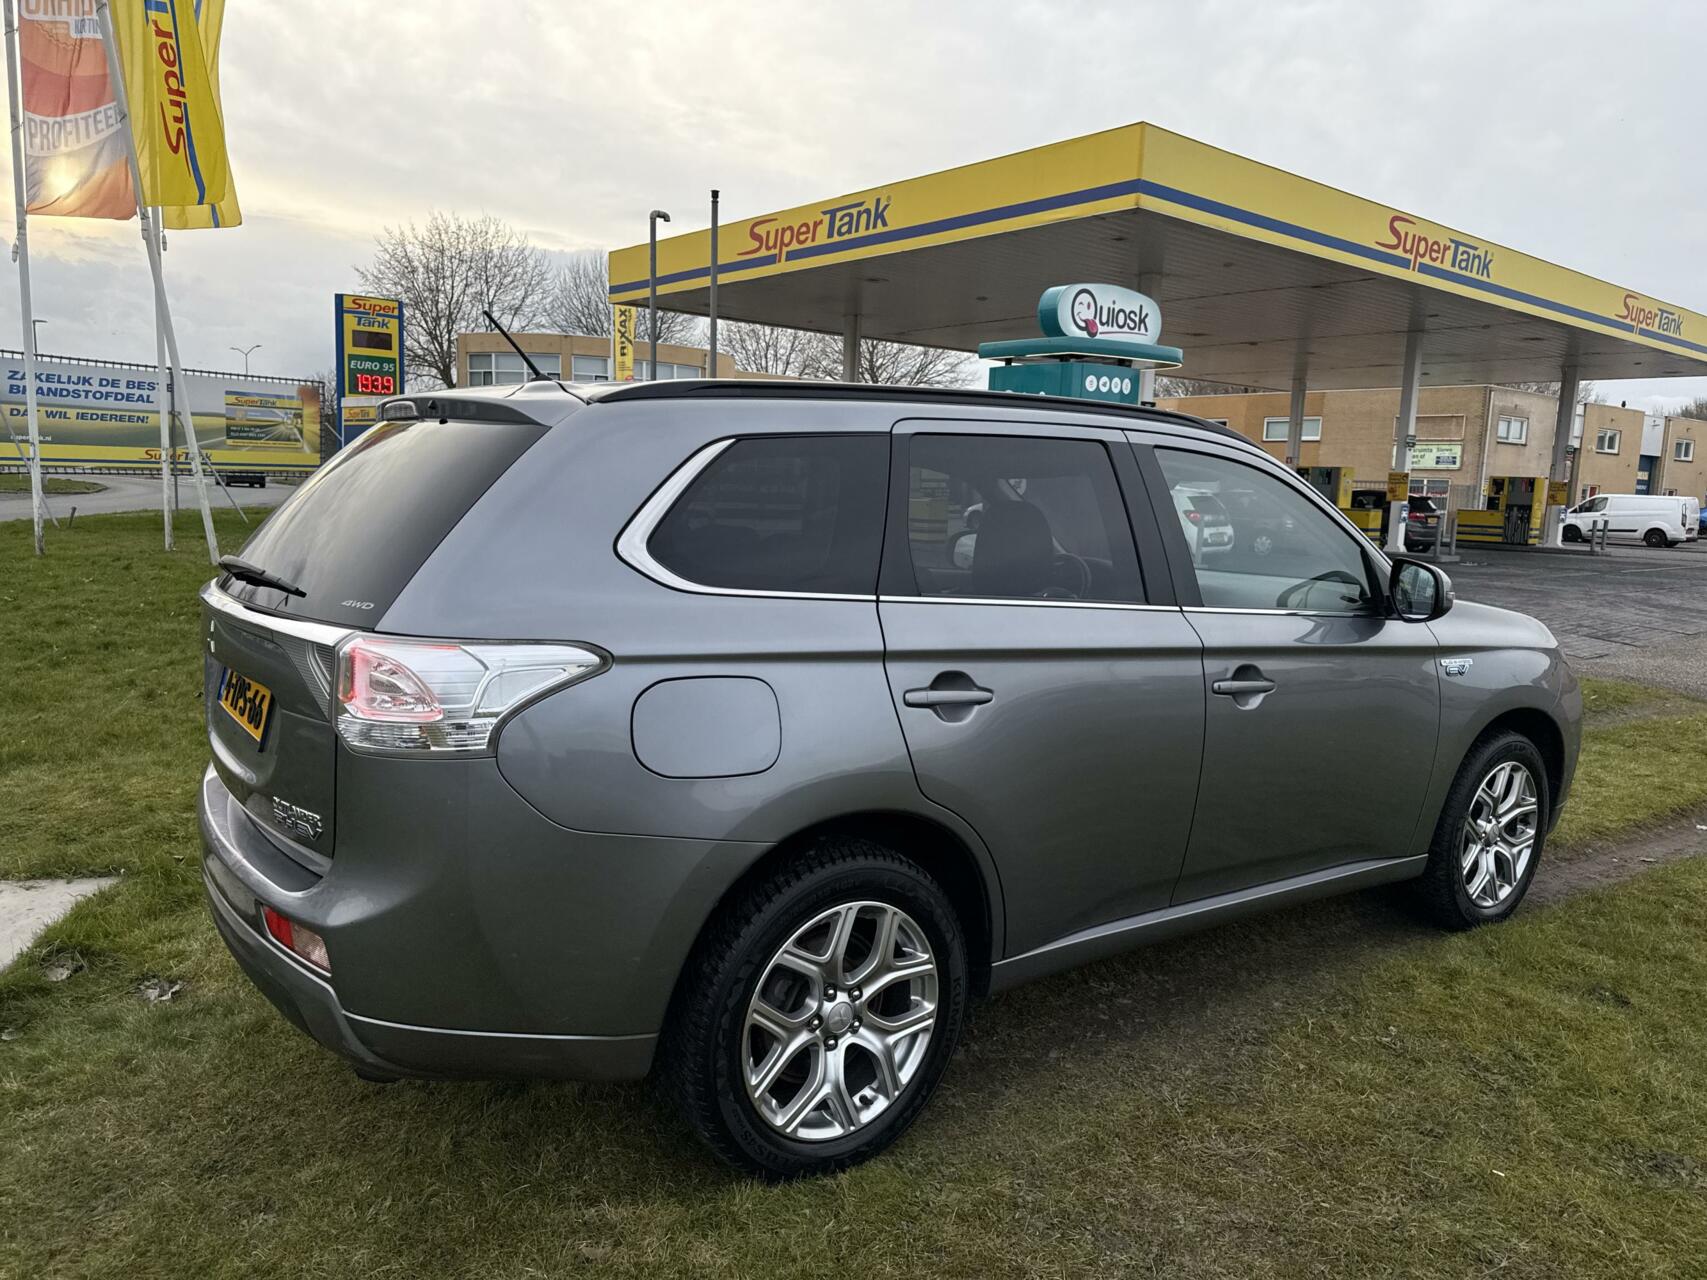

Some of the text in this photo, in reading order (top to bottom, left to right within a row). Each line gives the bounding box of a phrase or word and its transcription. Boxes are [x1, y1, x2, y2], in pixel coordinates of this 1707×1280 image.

[736, 197, 892, 263] SuperTank
[1375, 215, 1494, 279] SuperTank
[344, 298, 399, 316] Super
[1071, 288, 1149, 338] Quiosk
[353, 315, 390, 329] Tank
[350, 360, 395, 373] EURO 95
[98, 377, 121, 388] DE
[45, 410, 71, 420] WIL
[75, 411, 150, 424] IEDEREEN!
